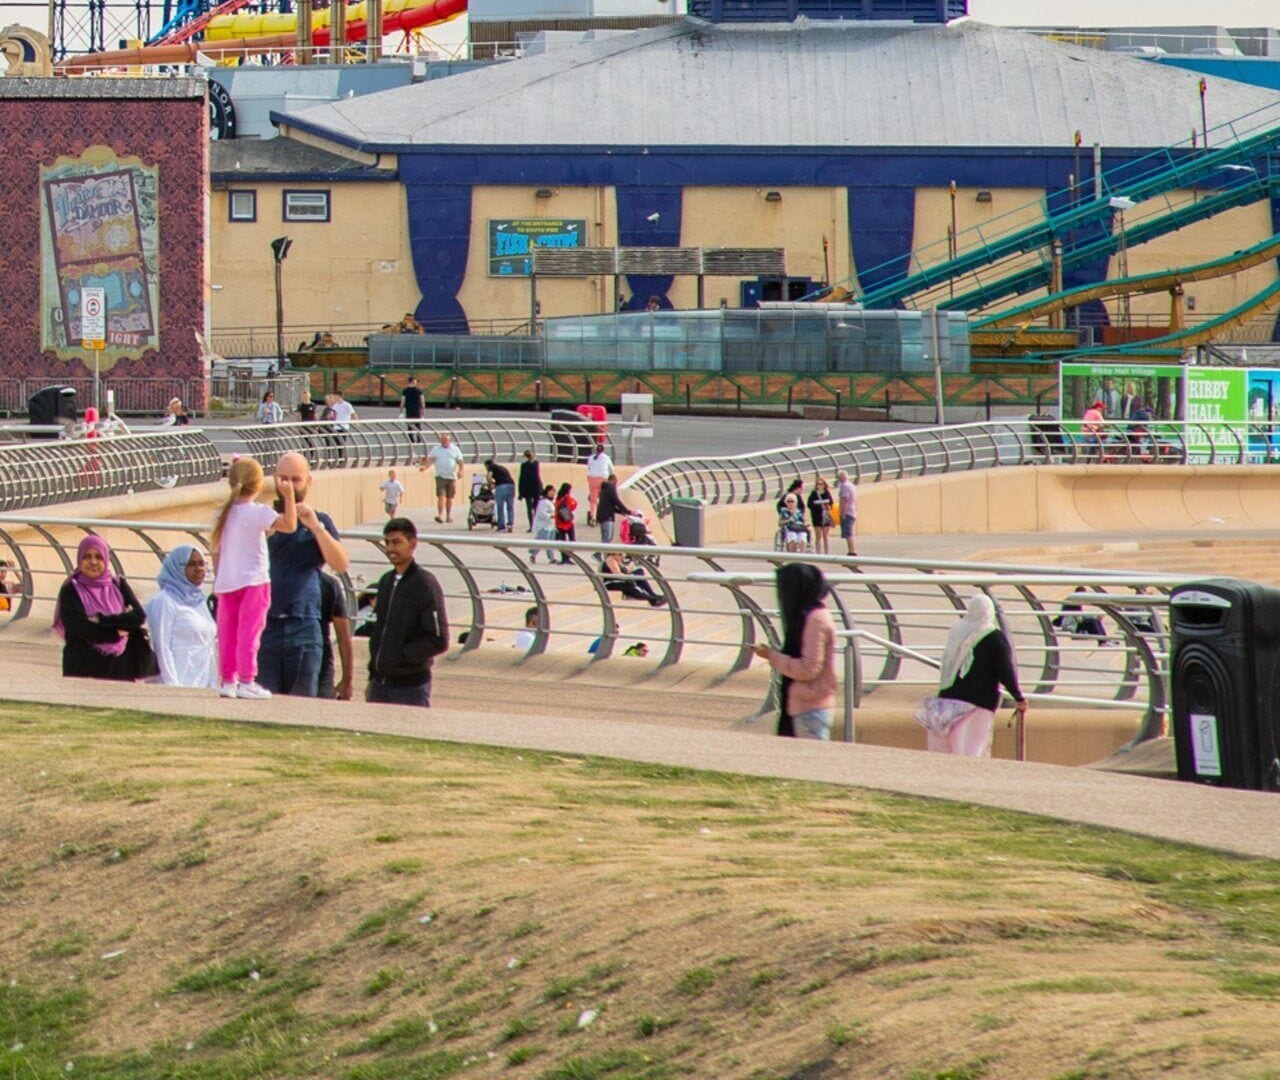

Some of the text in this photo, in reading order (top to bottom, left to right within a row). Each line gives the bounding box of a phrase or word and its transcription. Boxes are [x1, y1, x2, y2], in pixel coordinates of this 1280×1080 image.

[496, 232, 529, 256] FISH
[109, 331, 140, 345] IGHT
[1189, 380, 1231, 400] RIBBY
[1189, 404, 1224, 422] HALL
